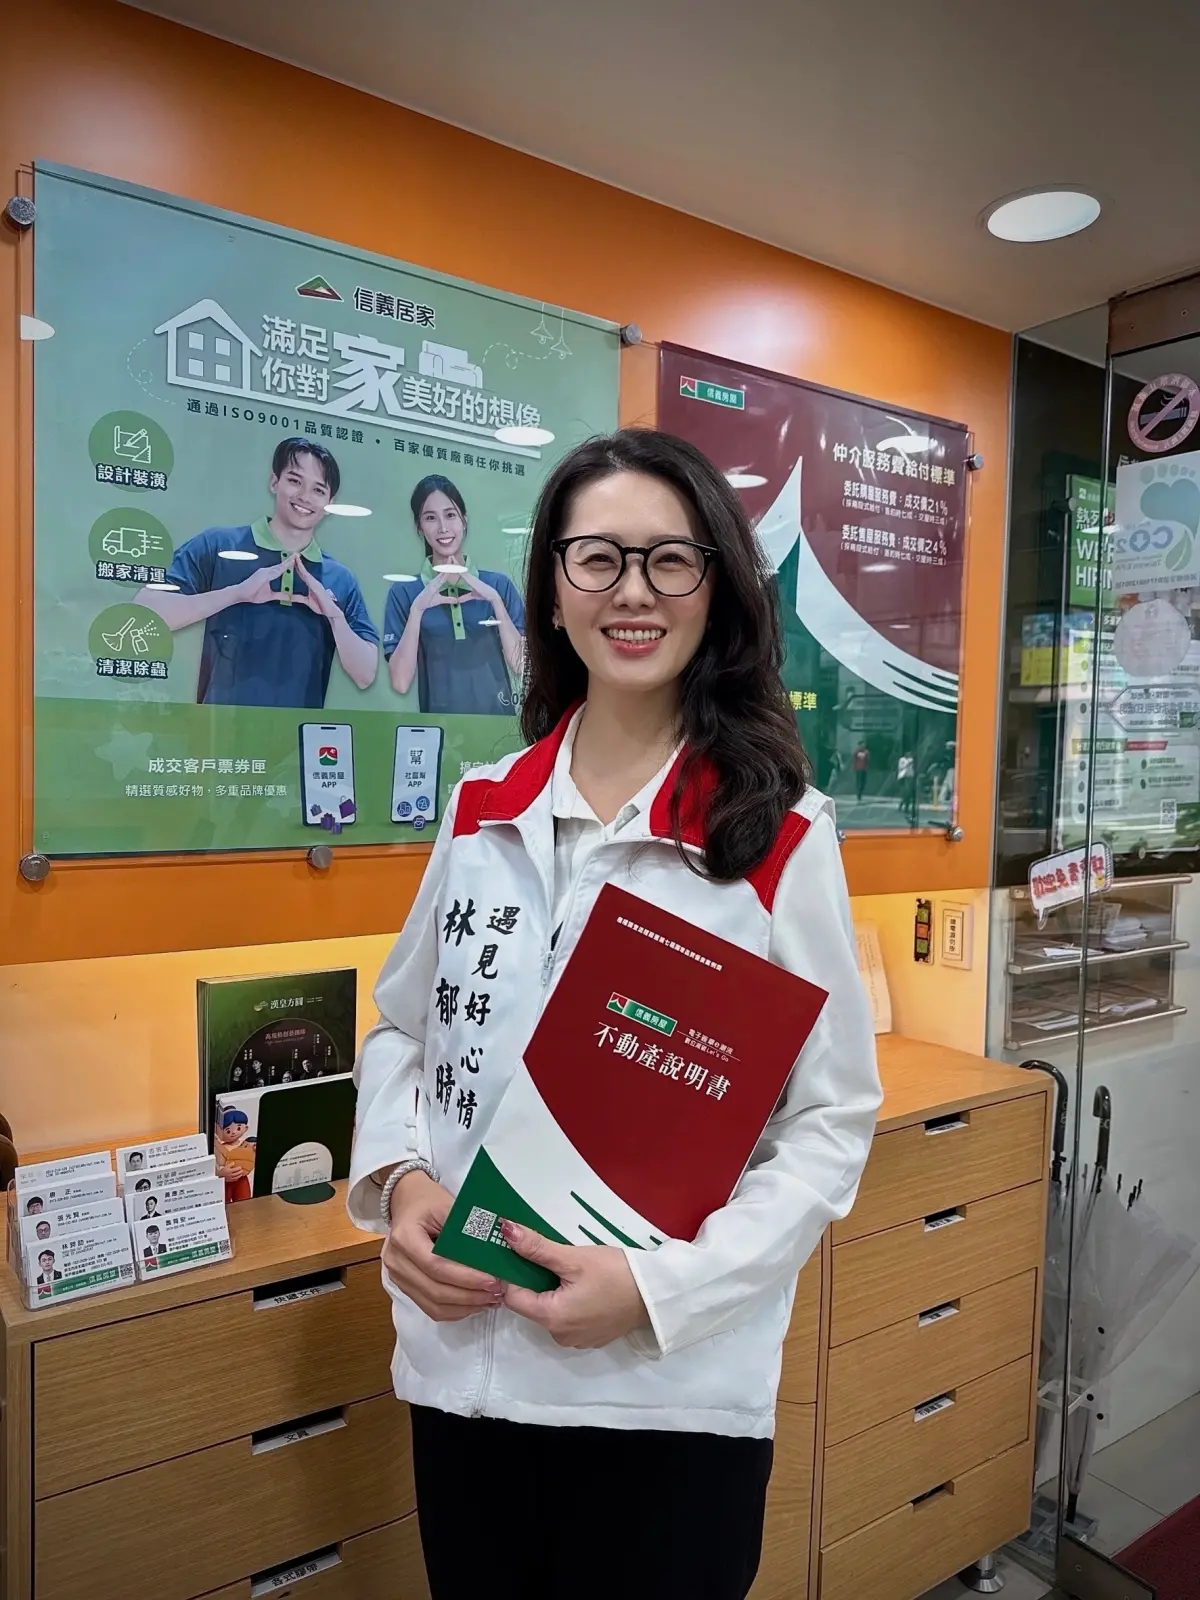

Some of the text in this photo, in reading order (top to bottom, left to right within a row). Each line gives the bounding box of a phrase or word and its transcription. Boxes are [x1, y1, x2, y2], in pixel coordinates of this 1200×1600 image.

[353, 286, 436, 329] 信義居家
[261, 314, 330, 362] 滿足
[261, 331, 542, 428] 你對 家 美好的想像
[706, 387, 738, 404] 信義房屋
[186, 398, 526, 477] 通過ISO9001品質認證 百家優質廠商任你挑選
[96, 464, 168, 489] 設計裝潢
[832, 442, 956, 487] 仲介服務費給付標準
[96, 561, 167, 584] 搬家清運
[97, 658, 168, 678] 清潔除蟲
[147, 757, 267, 775] 成交客戶票券匣
[312, 771, 346, 781] 信義房屋
[404, 771, 427, 781] 社區幫
[321, 781, 338, 789] APP
[407, 780, 423, 788] APP
[435, 898, 477, 1117] 林郁晴
[456, 905, 522, 1131] 遇見好心情
[634, 1007, 668, 1030] 信義房屋
[592, 1021, 732, 1101] 不動產說明書
